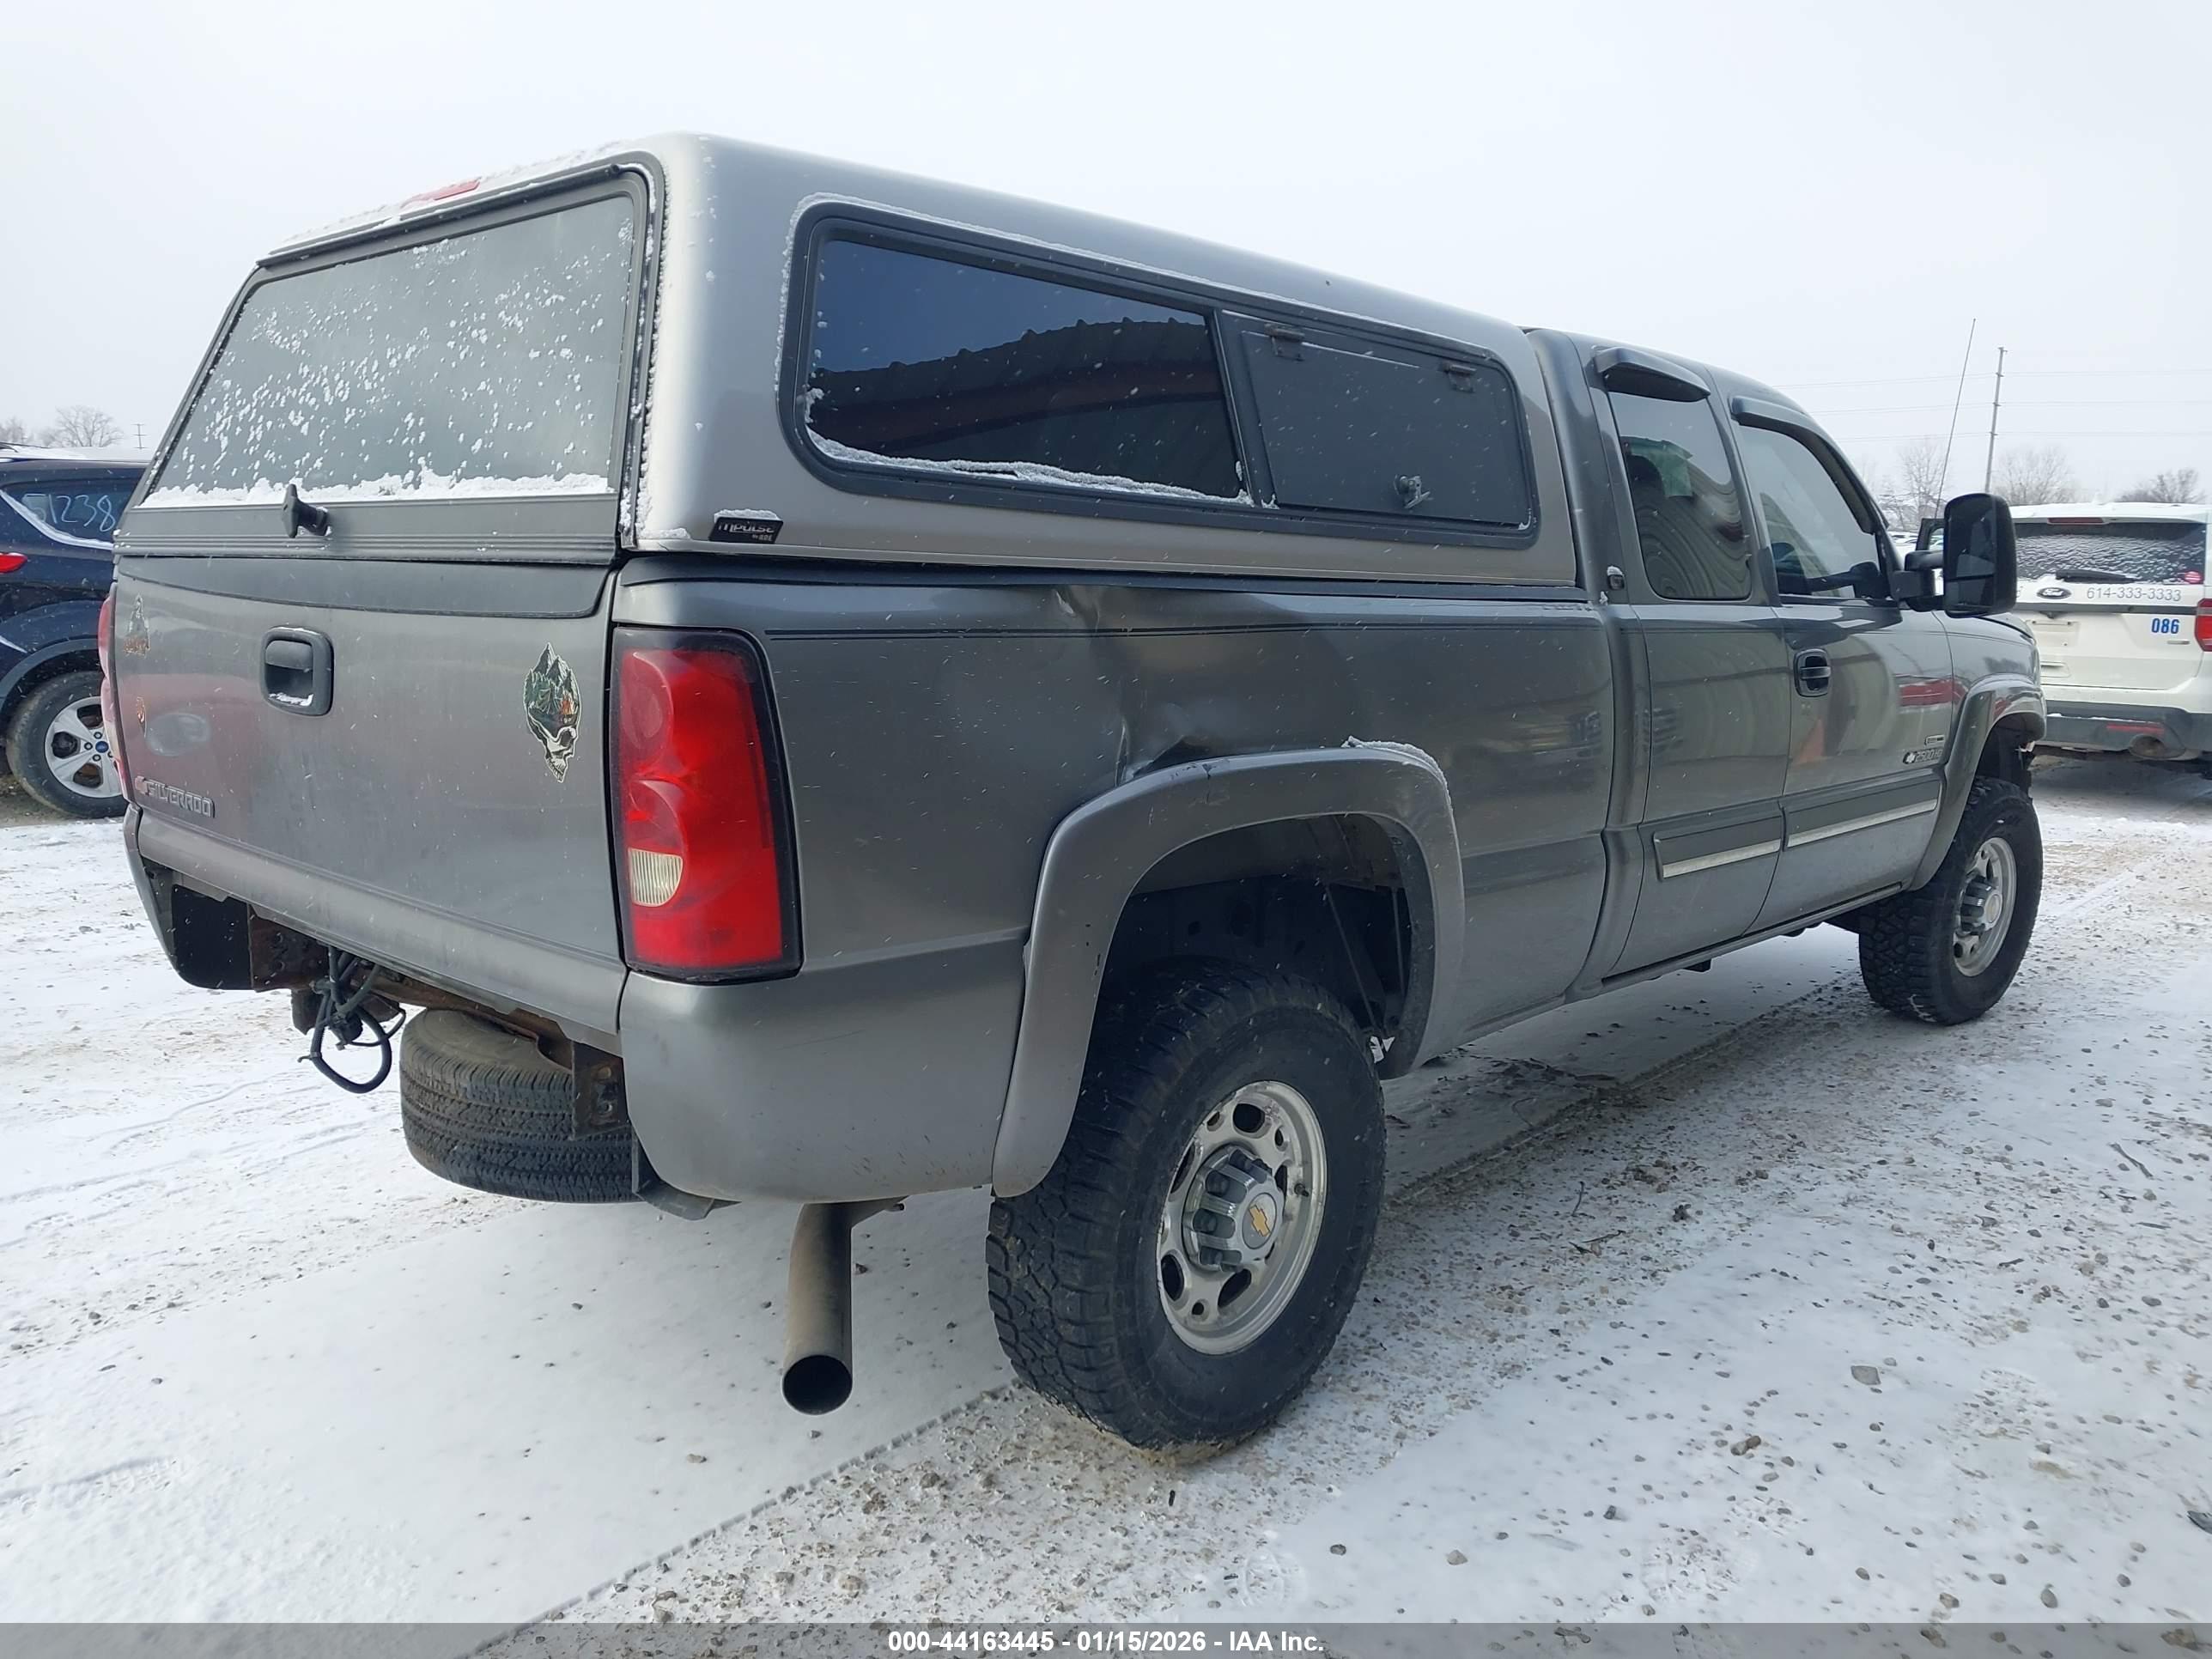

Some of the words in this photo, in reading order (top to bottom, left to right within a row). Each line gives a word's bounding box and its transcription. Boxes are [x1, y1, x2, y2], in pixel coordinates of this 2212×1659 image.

[2087, 586, 2182, 602] 614-333-3333
[2150, 617, 2180, 634] 086
[147, 782, 213, 817] SILVERADO
